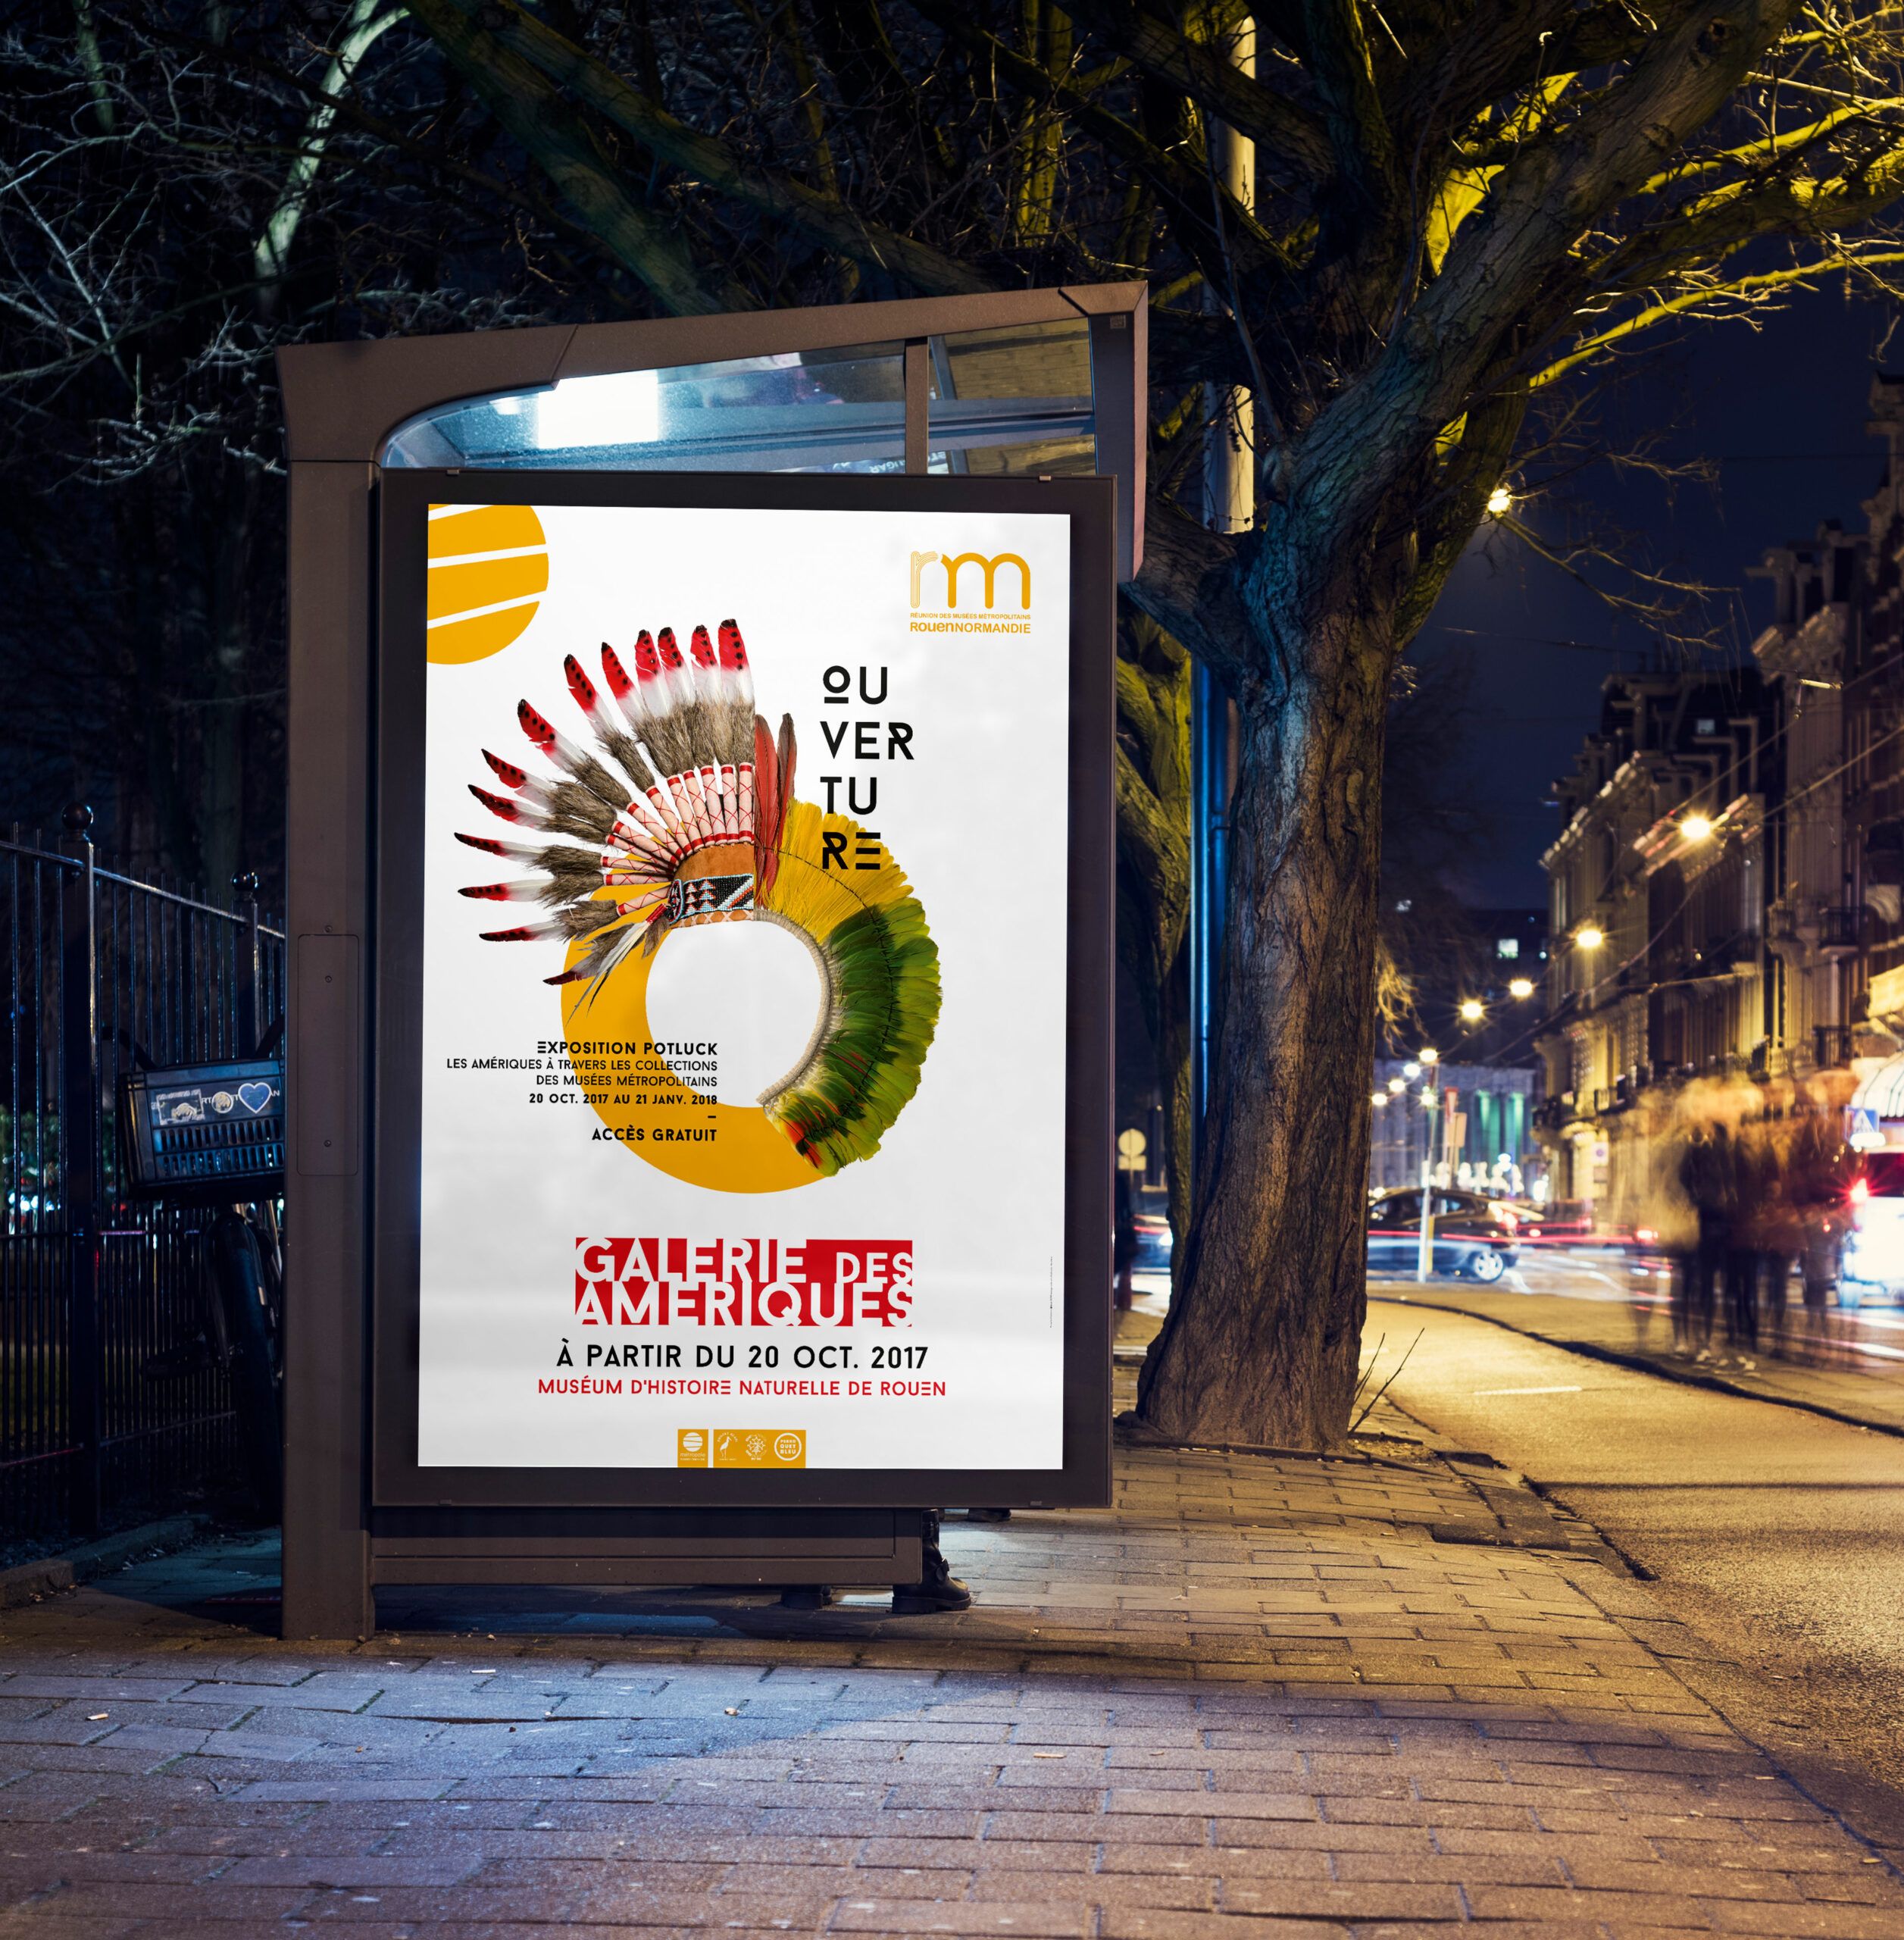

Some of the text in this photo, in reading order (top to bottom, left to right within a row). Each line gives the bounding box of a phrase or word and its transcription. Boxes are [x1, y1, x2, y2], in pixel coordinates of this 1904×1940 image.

[820, 721, 914, 760] VER
[820, 776, 877, 815] TU
[822, 831, 881, 871] RE
[538, 1041, 718, 1056] EXPOSITION POTLUCK
[447, 1056, 718, 1072] LES AMÉRIQUES À TRAVERS LES COLLECTIONS
[536, 1072, 718, 1087] DES MUSÉES MÉTROPOLITAINS
[529, 1093, 718, 1105] 20 OCT. 2017 AU 21 JANV. 2018
[592, 1125, 717, 1141] ACCÈS GRATUIT
[575, 1238, 913, 1284] GALERIE DES
[575, 1281, 913, 1327] AMERIQUES
[556, 1338, 928, 1369] À PARTIR DU 20 OCT. 2017
[538, 1375, 946, 1397] MUSÉUM D'HISTOIRE NATURELLE DE ROUEN
